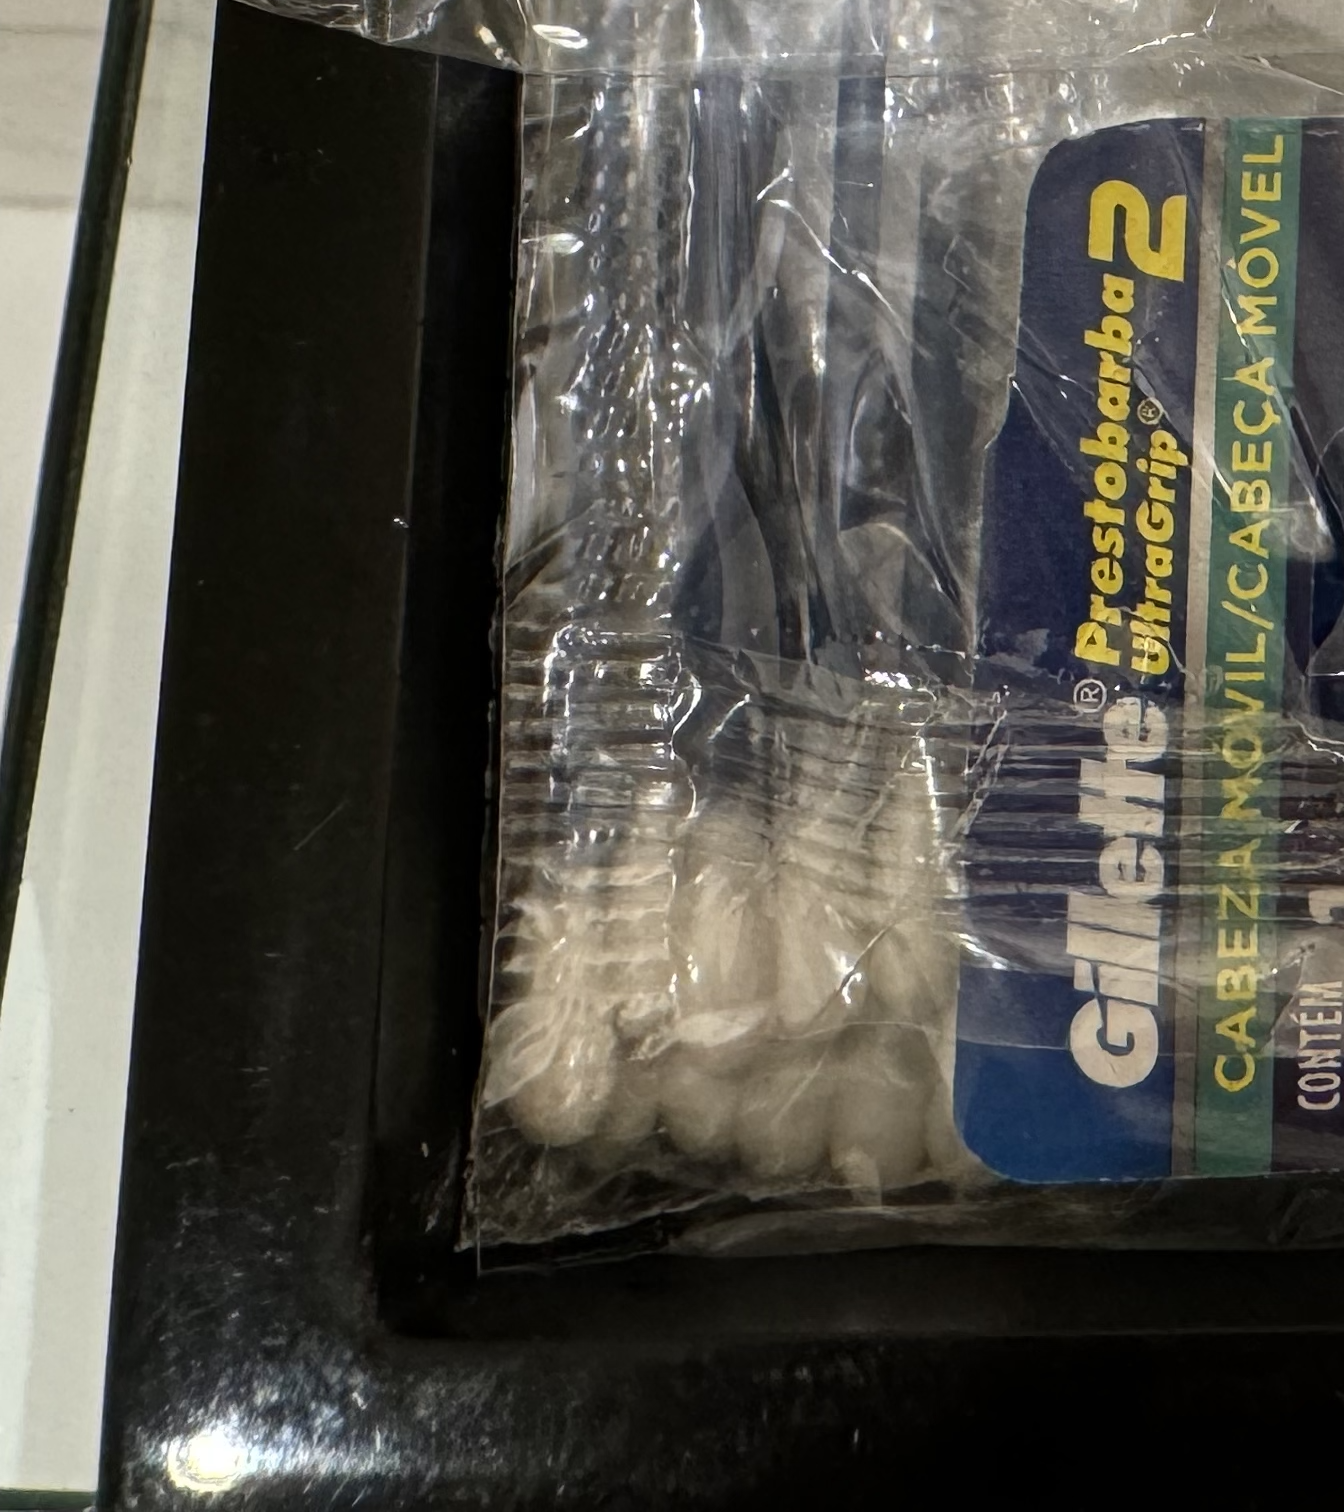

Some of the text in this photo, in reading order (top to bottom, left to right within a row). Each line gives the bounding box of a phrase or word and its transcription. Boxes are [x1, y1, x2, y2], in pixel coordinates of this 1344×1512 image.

[1225, 135, 1284, 335] MÓVEL
[1074, 179, 1187, 665] Prestobarba 2
[1214, 838, 1261, 1092] CABEZA
[1290, 981, 1342, 1110] CONTÉM
